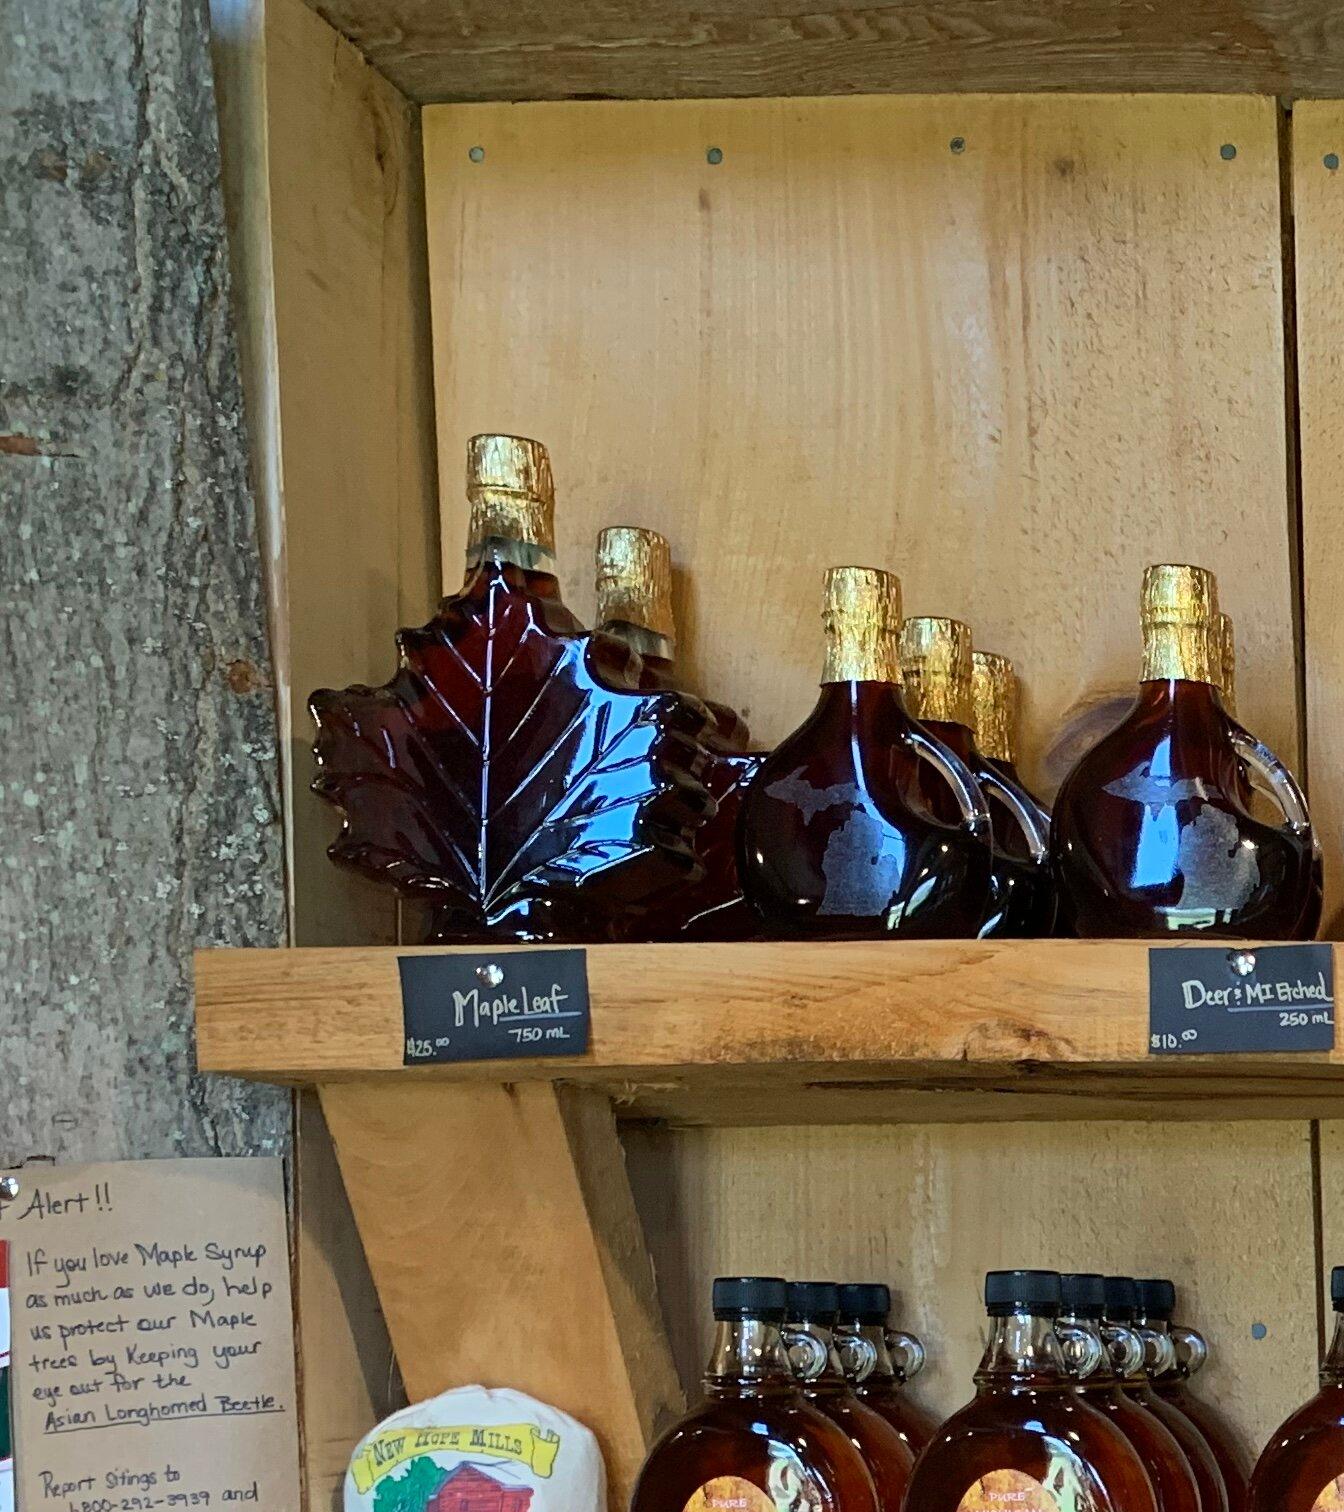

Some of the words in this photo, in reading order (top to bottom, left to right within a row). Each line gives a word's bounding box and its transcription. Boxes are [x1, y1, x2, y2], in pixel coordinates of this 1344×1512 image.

[453, 989, 520, 1028] Maple
[522, 983, 569, 1014] Leaf
[1182, 980, 1231, 1009] Deer
[1245, 983, 1274, 1004] MI
[1277, 972, 1334, 1002] Etched
[508, 1028, 543, 1043] 750
[1279, 1013, 1308, 1026] 250
[26, 1248, 48, 1276] If
[54, 1253, 86, 1288] you
[93, 1247, 128, 1268] love
[134, 1242, 197, 1269] Maple
[205, 1242, 267, 1269] Syrup
[26, 1293, 47, 1309] as
[54, 1287, 107, 1307] much
[114, 1286, 134, 1300] as
[143, 1280, 176, 1296] we
[222, 1276, 272, 1299] help
[30, 1324, 52, 1341] us
[60, 1315, 129, 1349] protect
[137, 1316, 176, 1331] our
[190, 1309, 257, 1328] Maple
[29, 1350, 78, 1370] trees
[89, 1350, 117, 1374] by
[213, 1341, 262, 1369] your
[32, 1385, 63, 1407] eye
[70, 1379, 103, 1395] out
[113, 1373, 146, 1392] for
[153, 1373, 191, 1389] the
[44, 1409, 96, 1431] Asian
[415, 1428, 460, 1448] HOPE
[469, 1429, 523, 1455] MILLS
[39, 1470, 96, 1499] Report
[163, 1464, 180, 1482] to
[222, 1481, 259, 1502] and
[989, 1492, 1025, 1501] PURE
